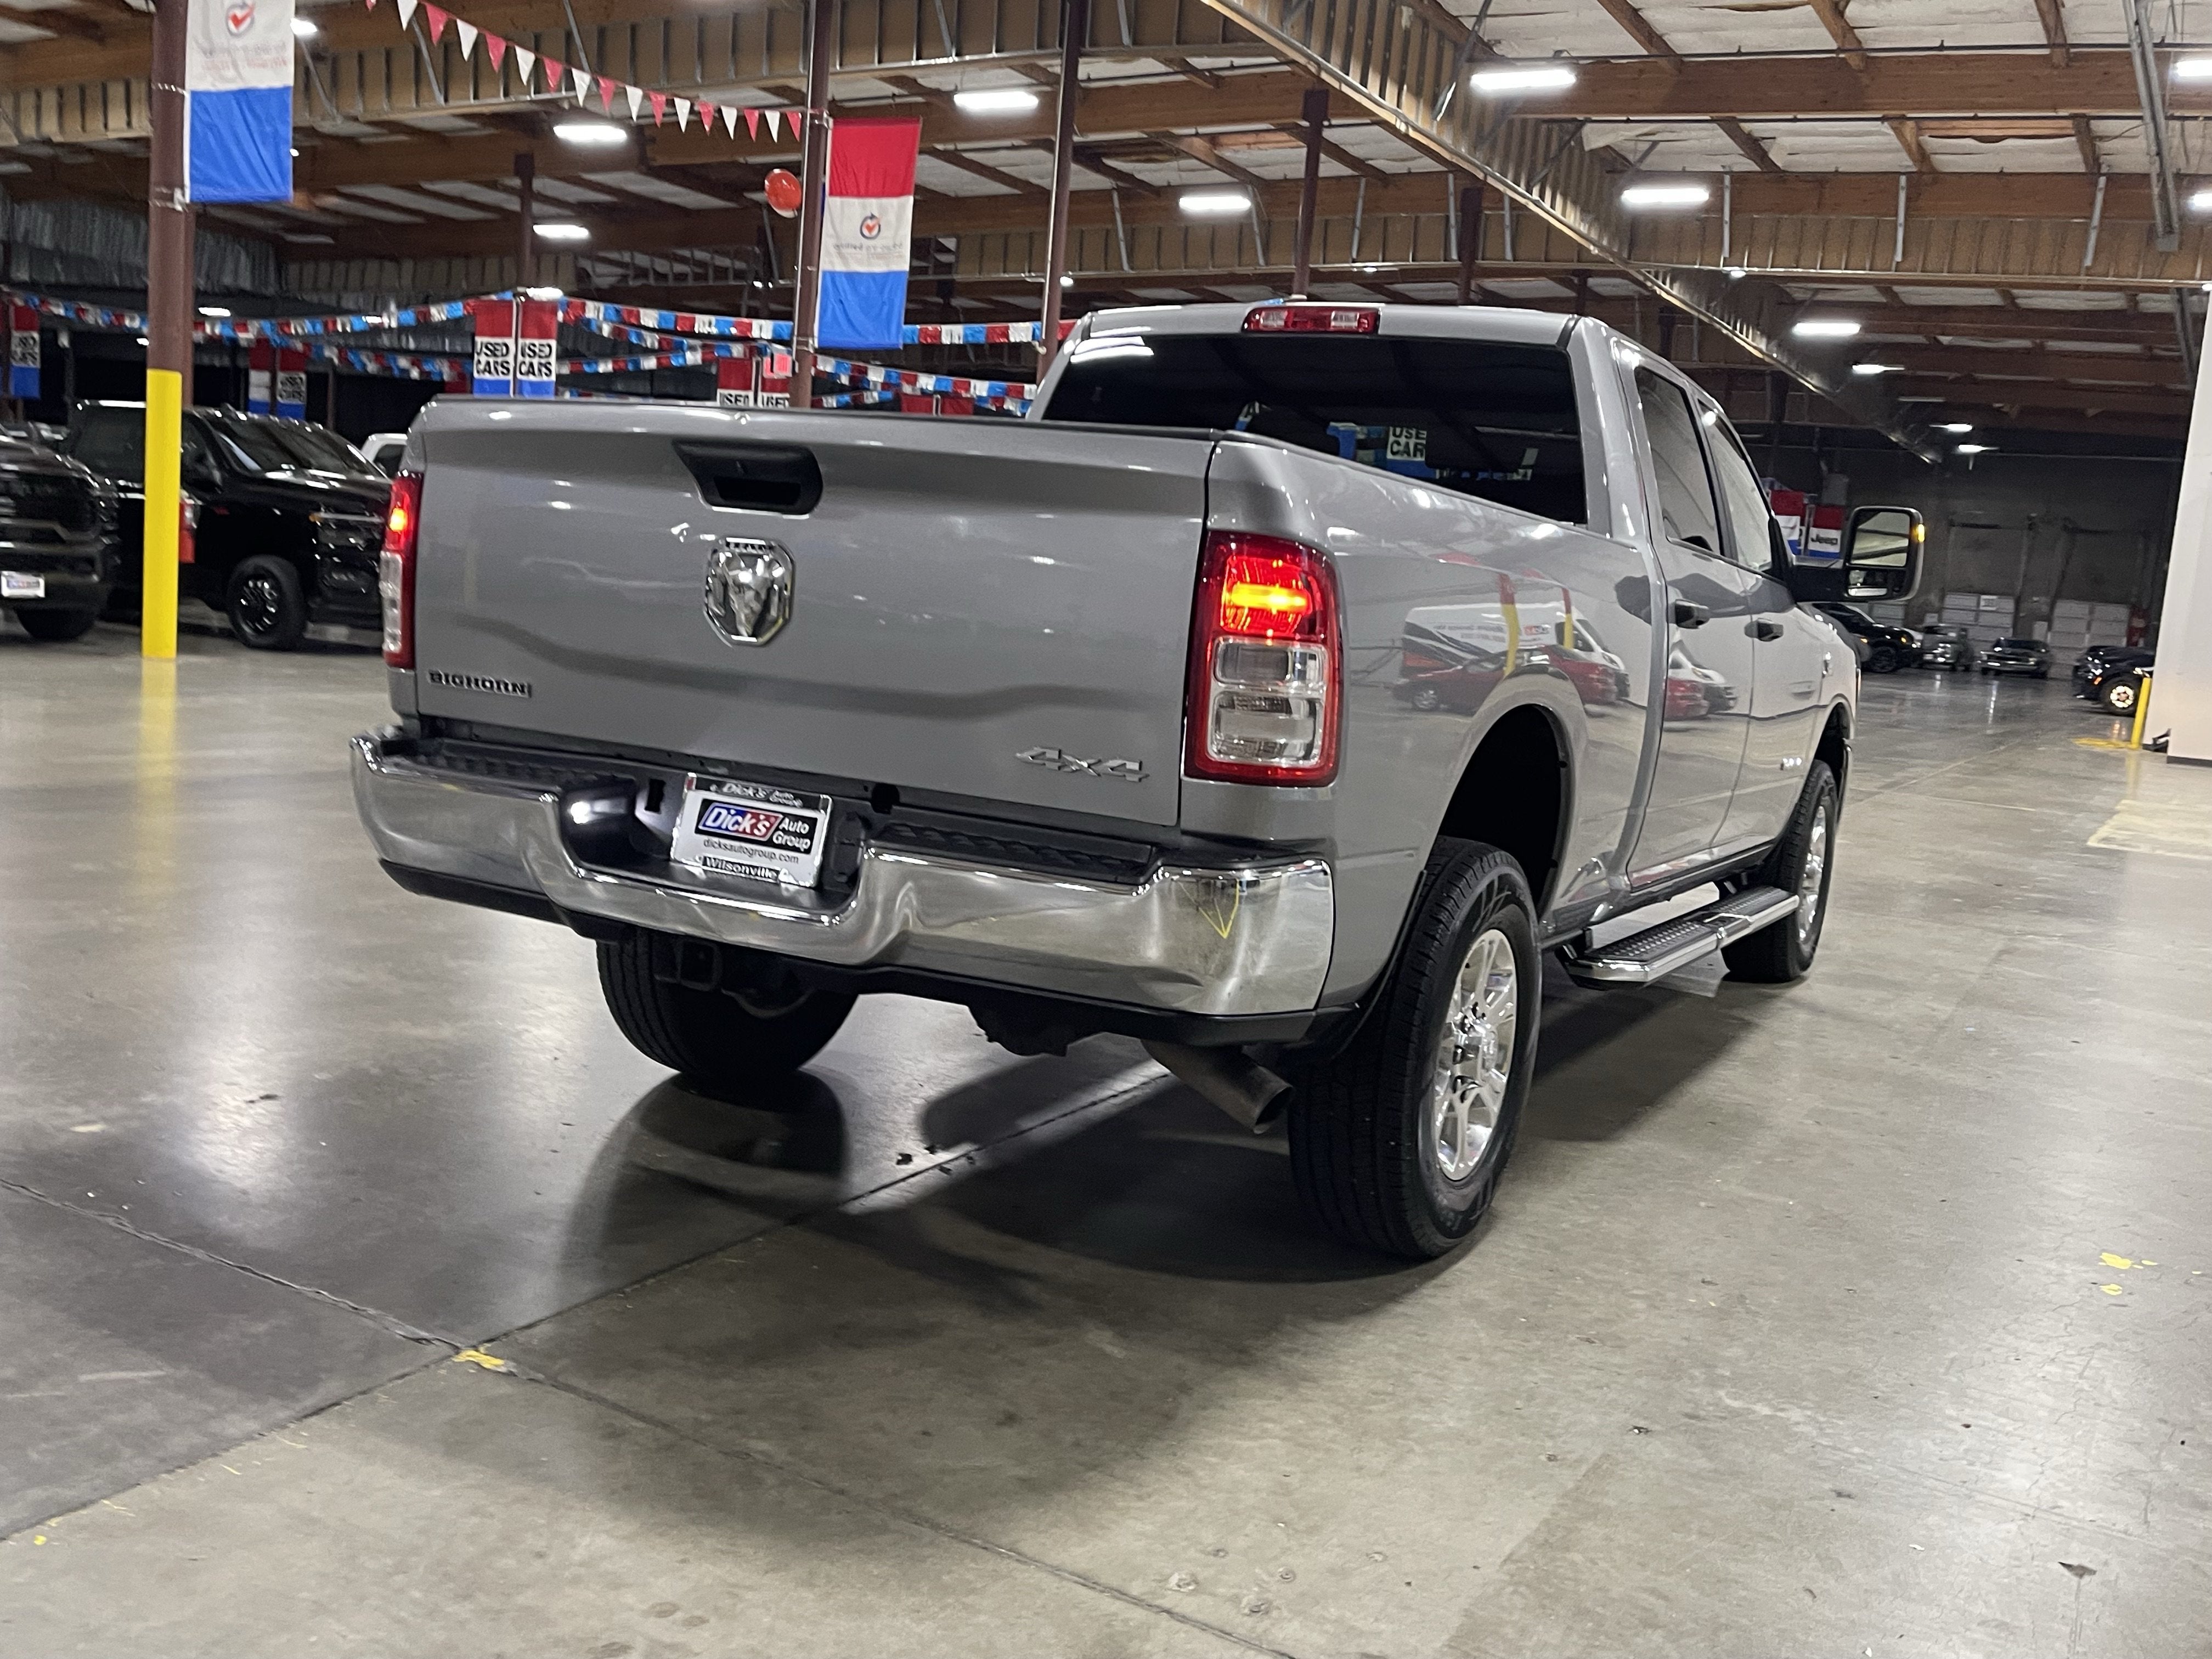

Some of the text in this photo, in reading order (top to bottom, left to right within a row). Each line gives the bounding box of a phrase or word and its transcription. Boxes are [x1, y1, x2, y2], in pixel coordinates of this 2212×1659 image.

[476, 341, 510, 357] USED
[521, 342, 552, 358] USED
[519, 360, 552, 377] CARS
[723, 782, 768, 799] Dick's
[705, 807, 810, 837] Dick's Auto
[772, 831, 811, 851] Group
[703, 838, 799, 865] dicksautogroup.com
[706, 856, 777, 878] Wilsonville
